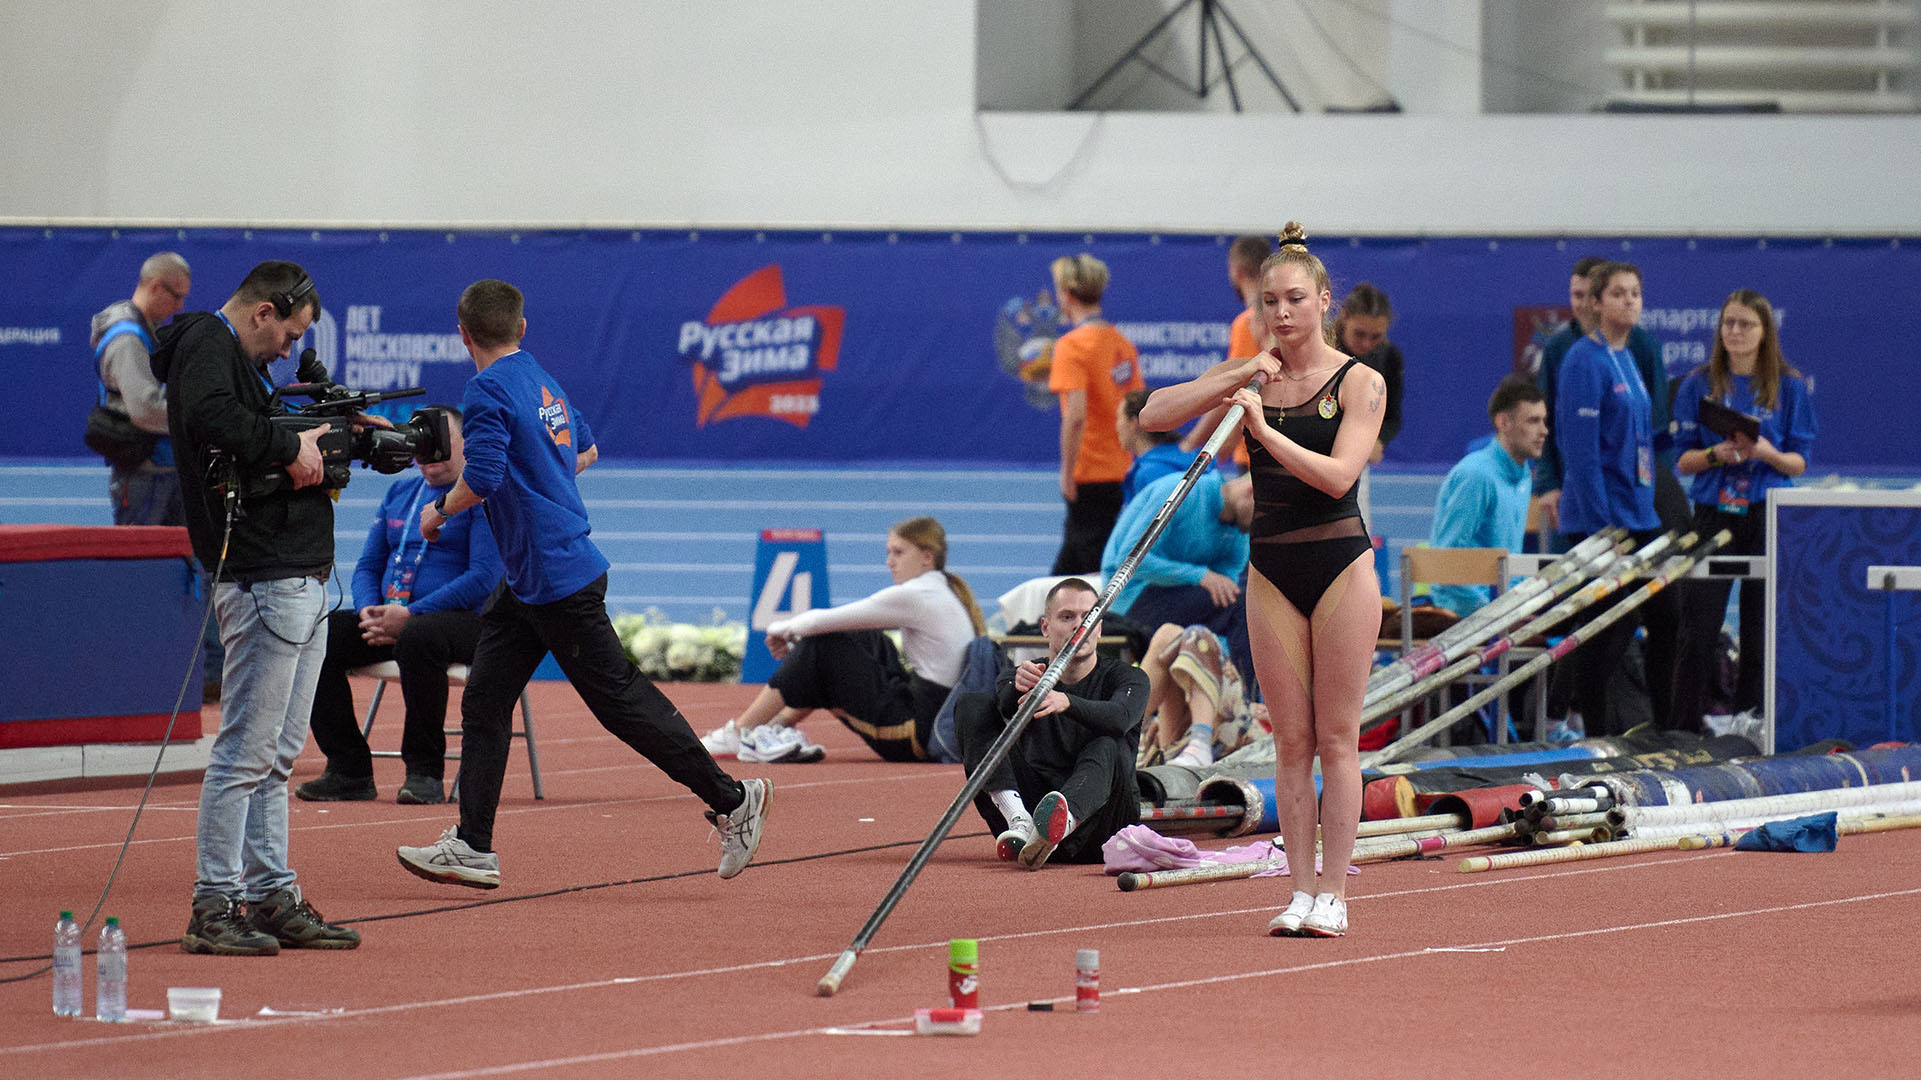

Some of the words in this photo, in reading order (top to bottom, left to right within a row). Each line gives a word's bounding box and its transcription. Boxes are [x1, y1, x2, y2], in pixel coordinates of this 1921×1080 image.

[346, 305, 380, 332] ЛЕТ
[346, 333, 472, 362] МОСКОВСКО
[678, 316, 815, 360] Русская
[345, 361, 421, 389] СПОРТУ
[719, 344, 809, 382] Зима
[751, 551, 812, 631] 4
